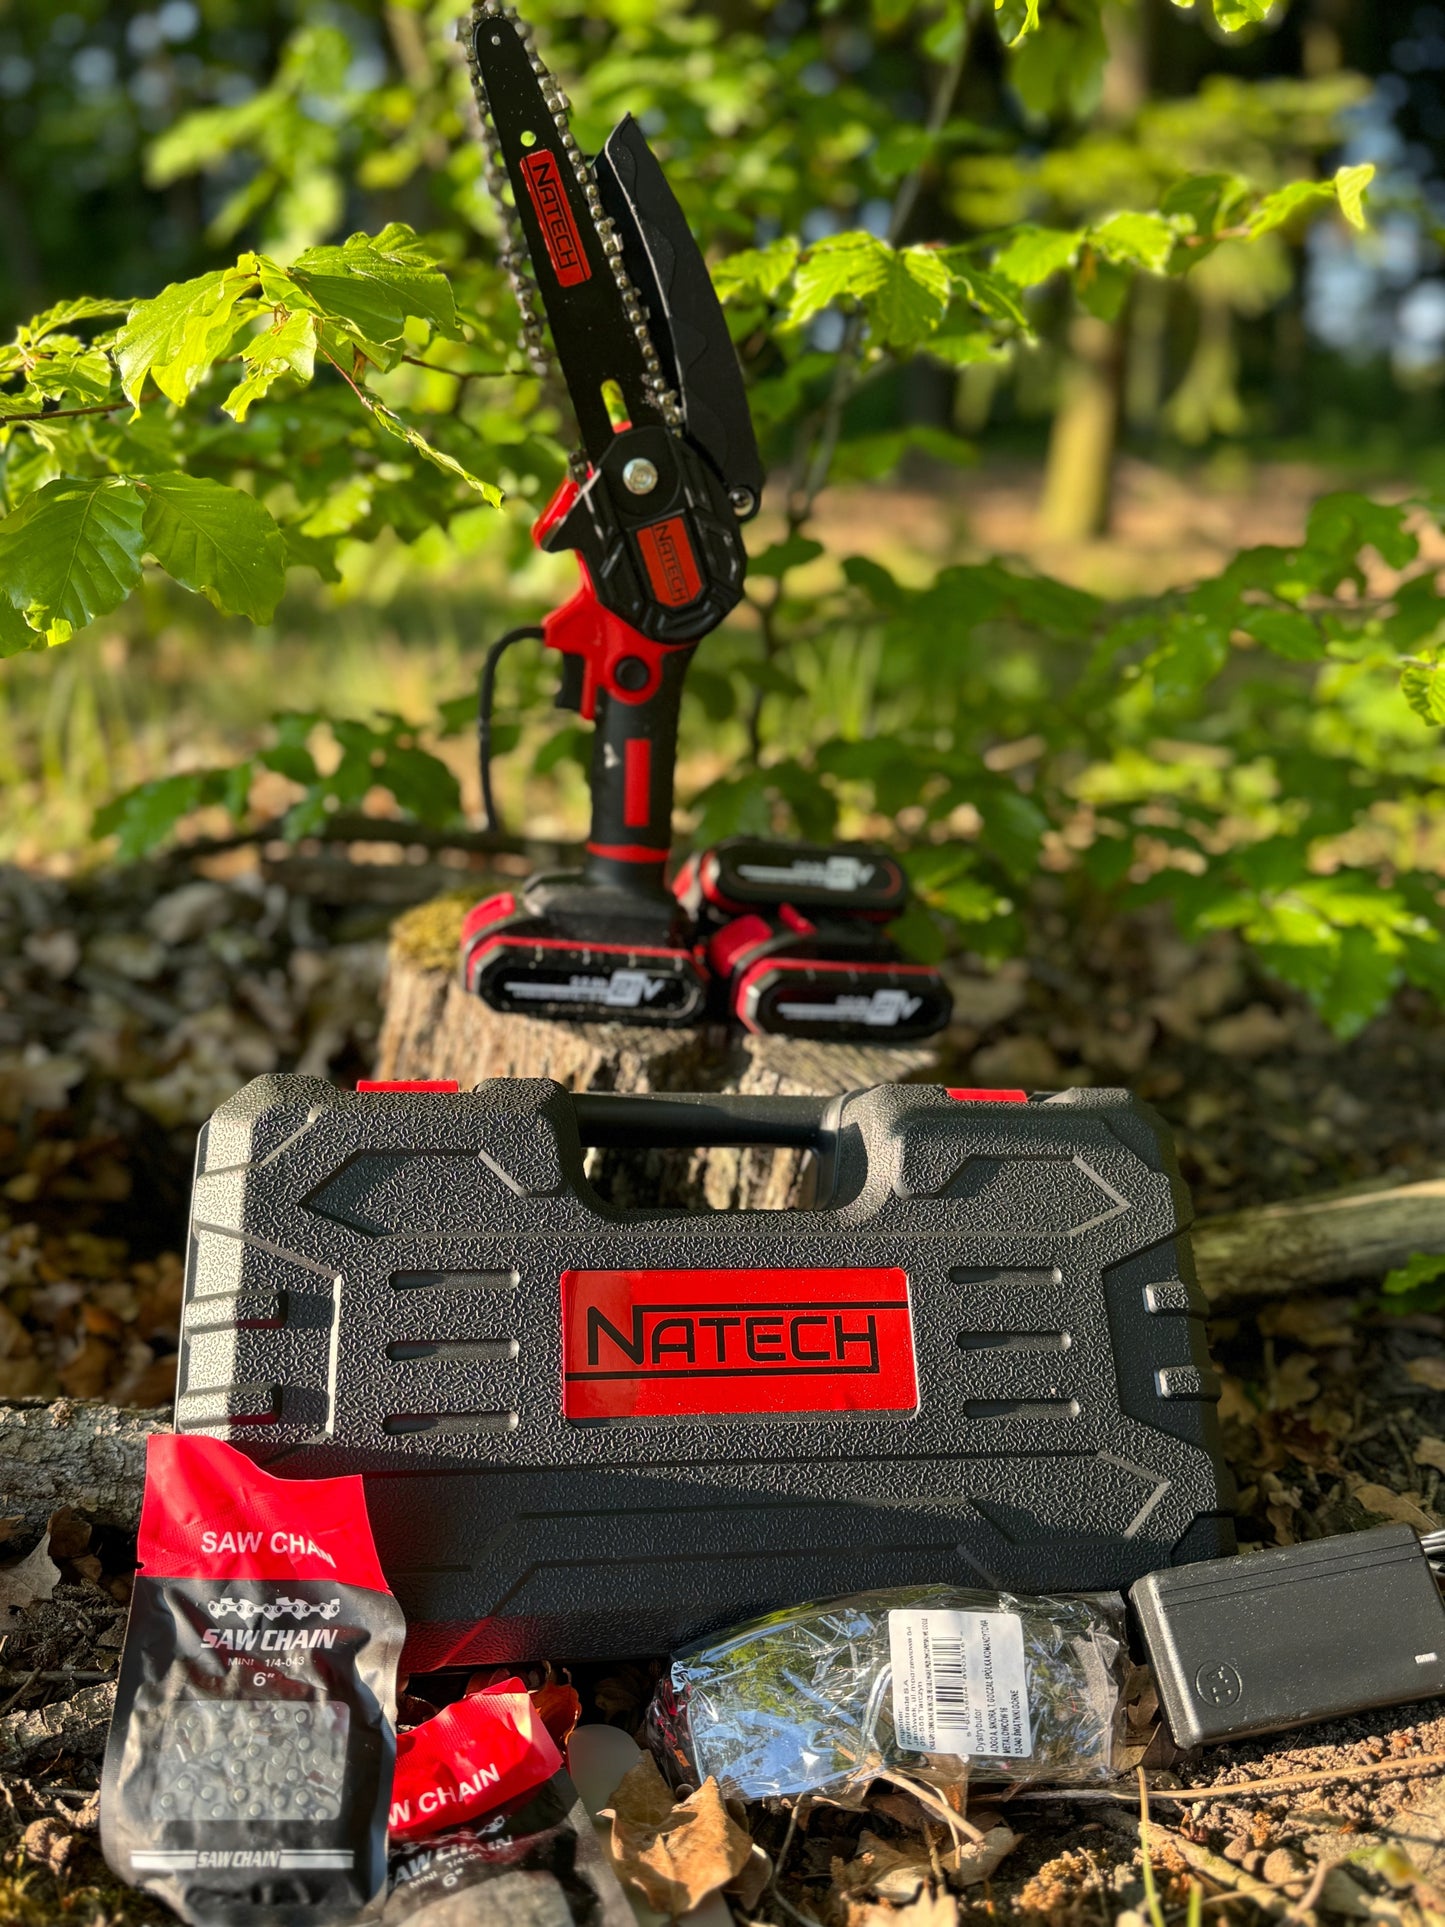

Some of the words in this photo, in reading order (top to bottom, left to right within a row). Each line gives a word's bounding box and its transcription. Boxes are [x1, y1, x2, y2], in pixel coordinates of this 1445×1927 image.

[532, 162, 578, 269] NATECH
[655, 524, 689, 602] NATECH
[587, 1304, 878, 1368] NATECH
[201, 1531, 262, 1553] SAW
[200, 1628, 259, 1650] SAW
[260, 1628, 338, 1650] CHAIN
[980, 1620, 991, 1658] KOMANDYTOWA
[228, 1657, 254, 1666] MINI
[265, 1656, 305, 1667] 1/4-043
[253, 1671, 275, 1686] 6"
[974, 1709, 984, 1752] Dystrybutor
[418, 1763, 500, 1813] CHAIN
[197, 1850, 230, 1868] SAW
[231, 1850, 281, 1868] CHAIN
[409, 1870, 438, 1888] MINI
[442, 1867, 463, 1887] 6"
